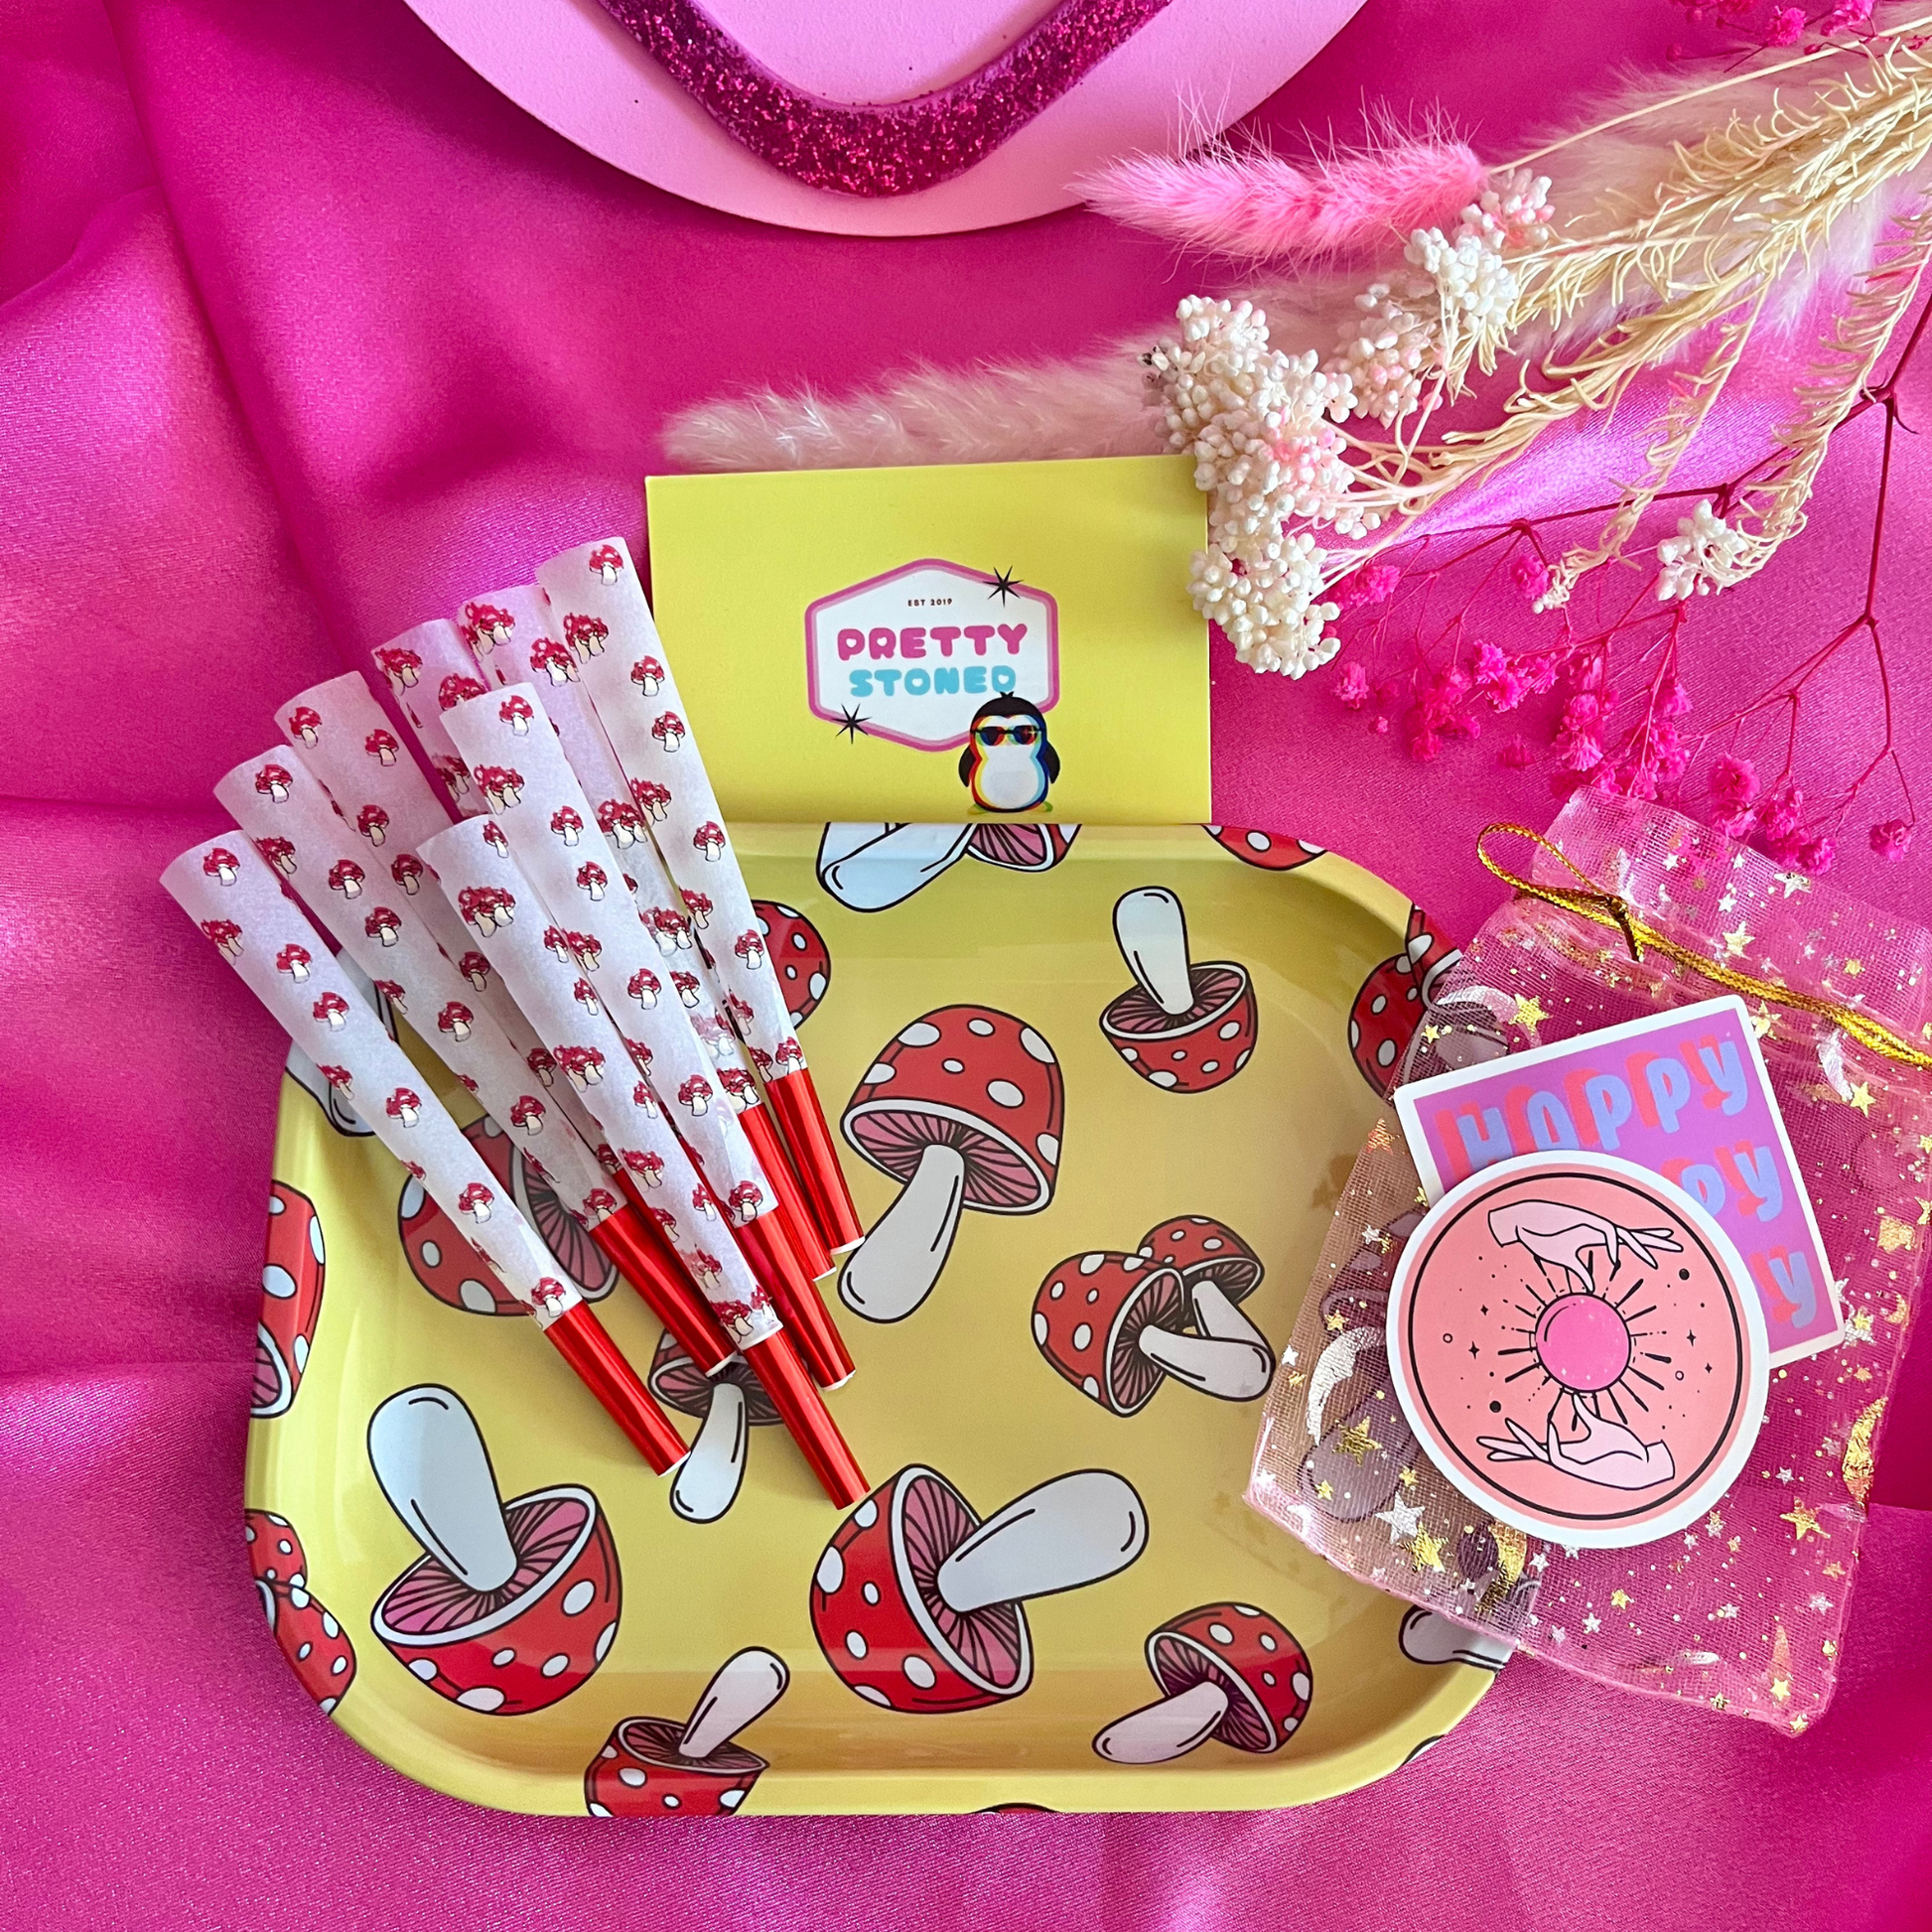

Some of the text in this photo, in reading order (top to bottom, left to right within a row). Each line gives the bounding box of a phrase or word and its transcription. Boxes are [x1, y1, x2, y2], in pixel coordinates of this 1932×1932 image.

[930, 598, 953, 607] 2019
[837, 623, 1028, 661] PRETTY
[849, 665, 1017, 697] STONED
